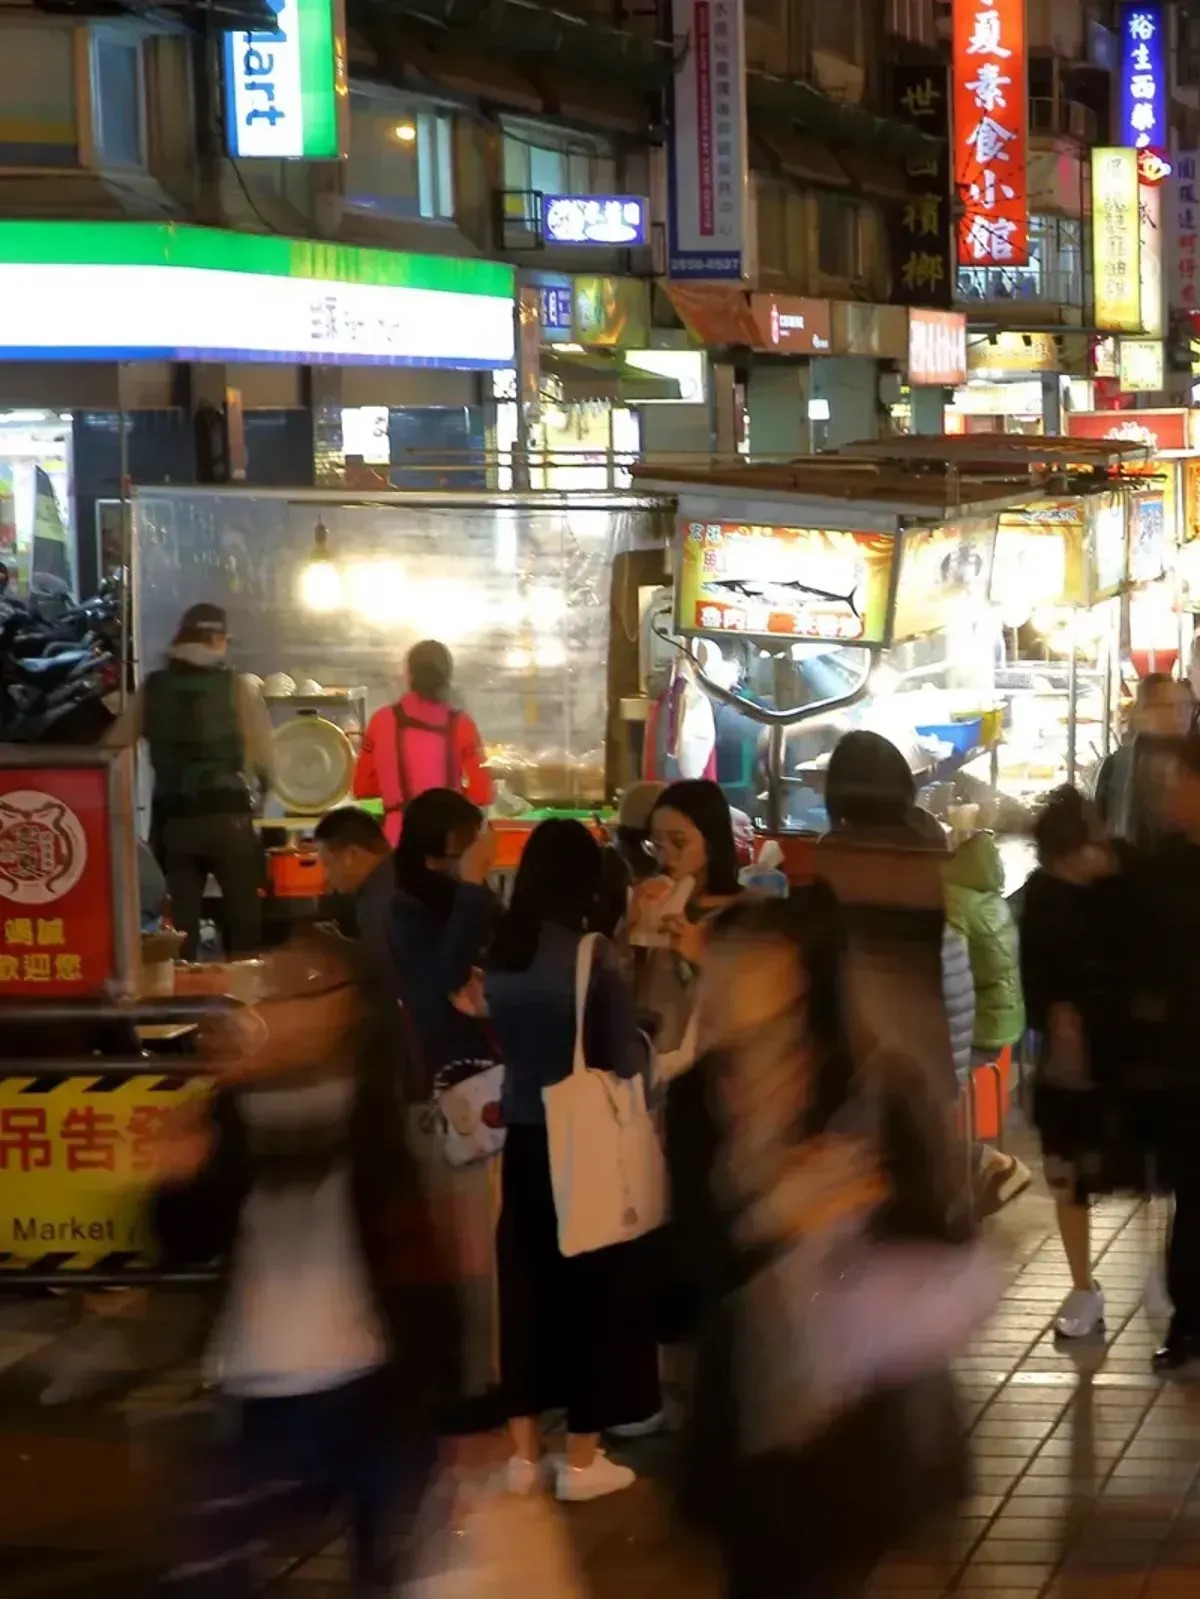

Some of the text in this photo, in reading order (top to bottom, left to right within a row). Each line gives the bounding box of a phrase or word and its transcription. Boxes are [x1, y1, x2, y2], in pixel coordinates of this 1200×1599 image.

[964, 0, 1017, 259] 夏素食小館
[12, 1217, 116, 1241] Market
